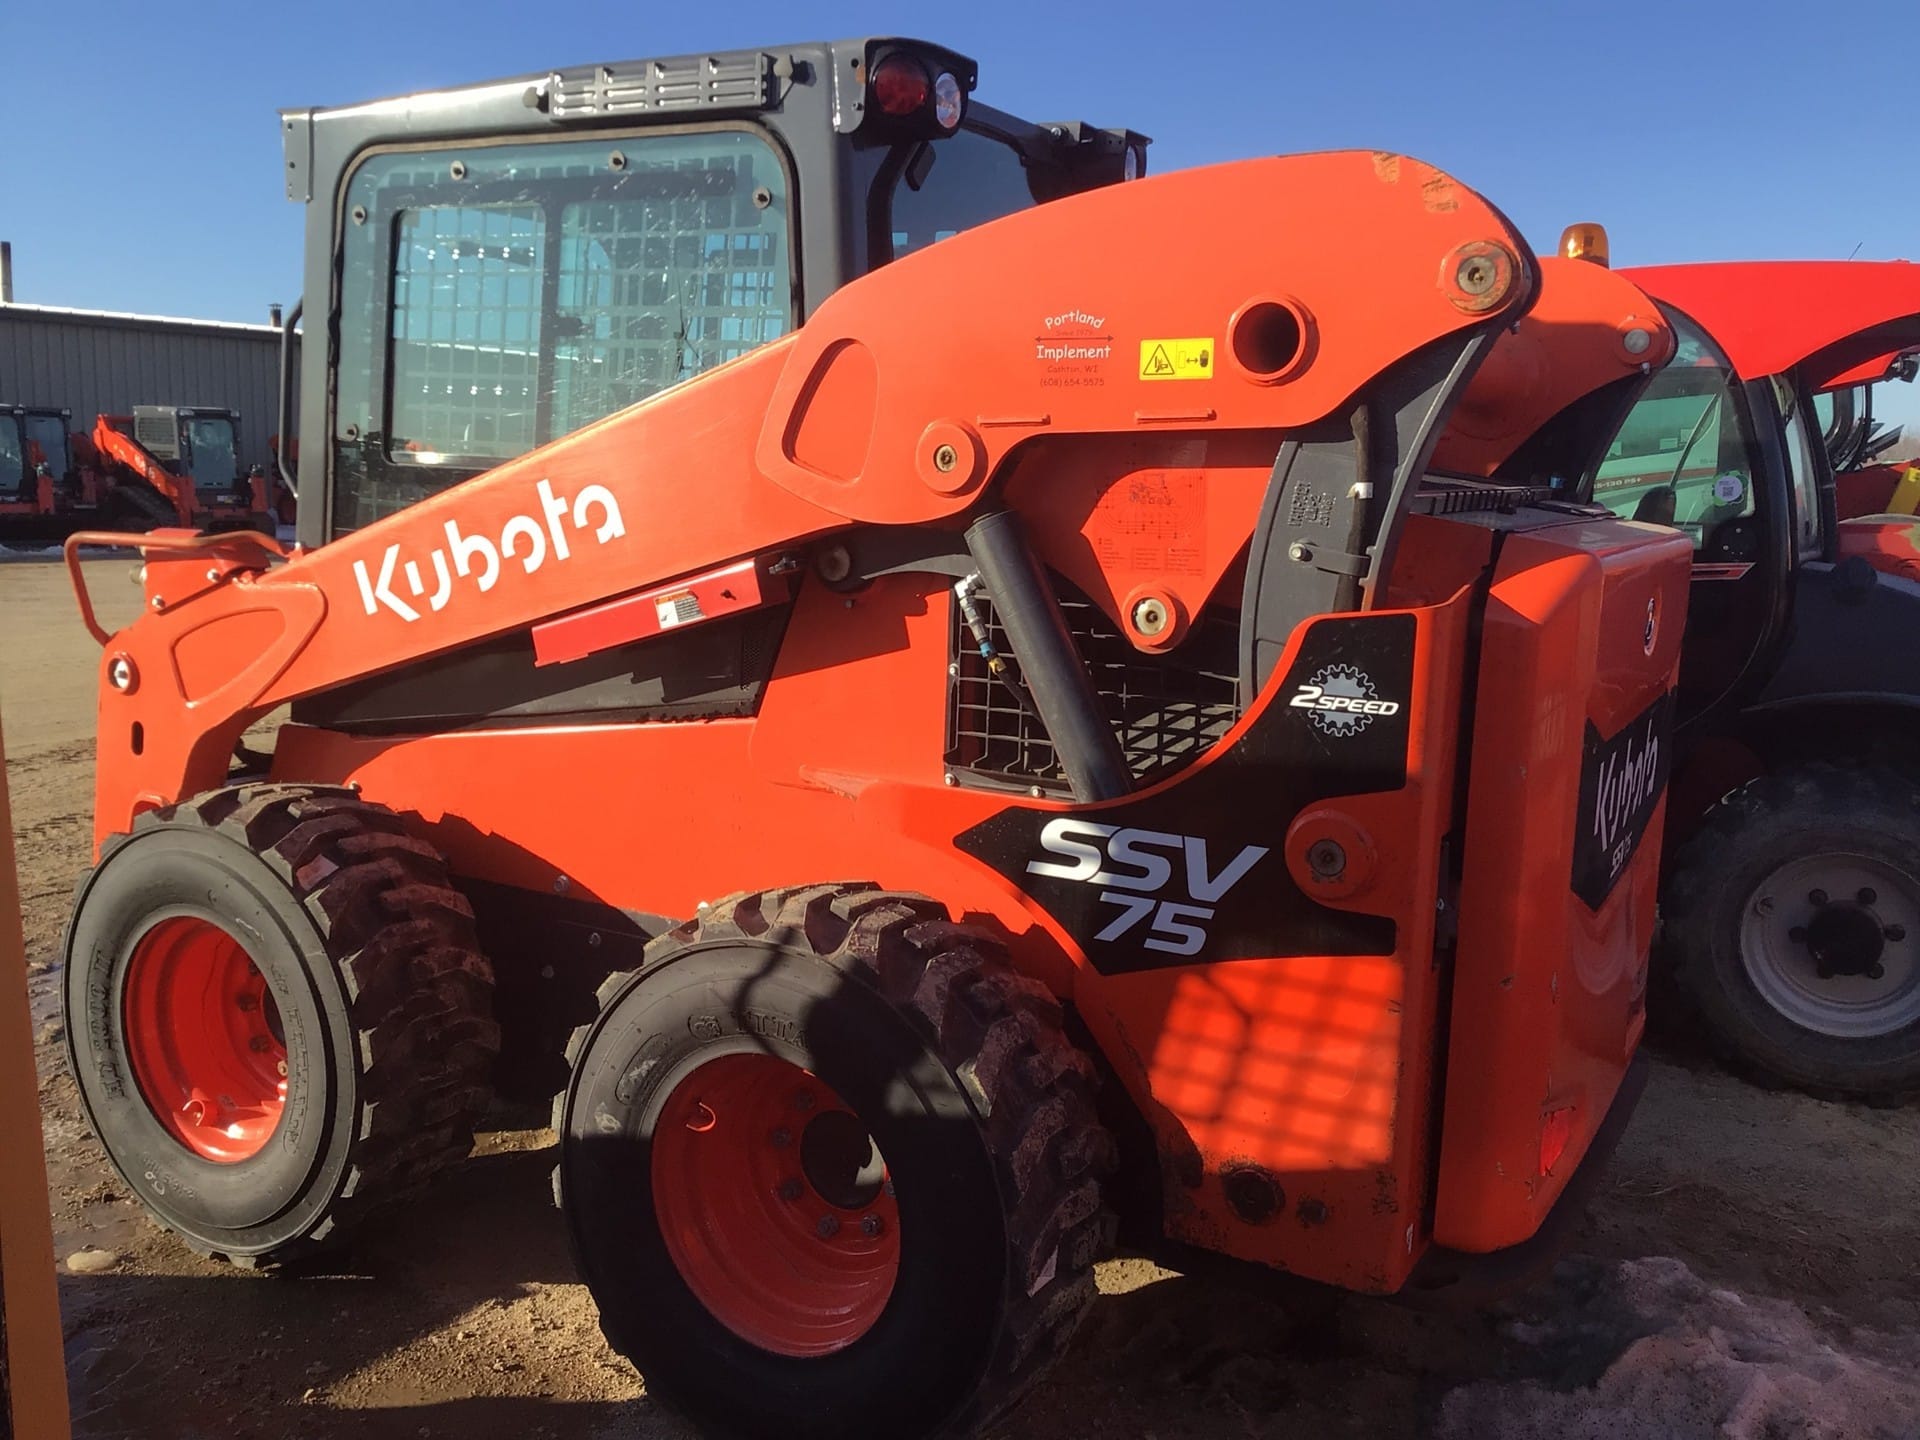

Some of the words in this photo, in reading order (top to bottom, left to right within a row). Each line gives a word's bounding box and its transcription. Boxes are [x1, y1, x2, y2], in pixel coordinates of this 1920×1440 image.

[1045, 309, 1105, 329] Portland
[1036, 344, 1111, 363] Implement
[1084, 364, 1098, 373] WI
[352, 478, 626, 623] Kubota
[1593, 718, 1659, 853] Kubota
[1025, 817, 1270, 903] SSV
[1093, 890, 1216, 957] 75
